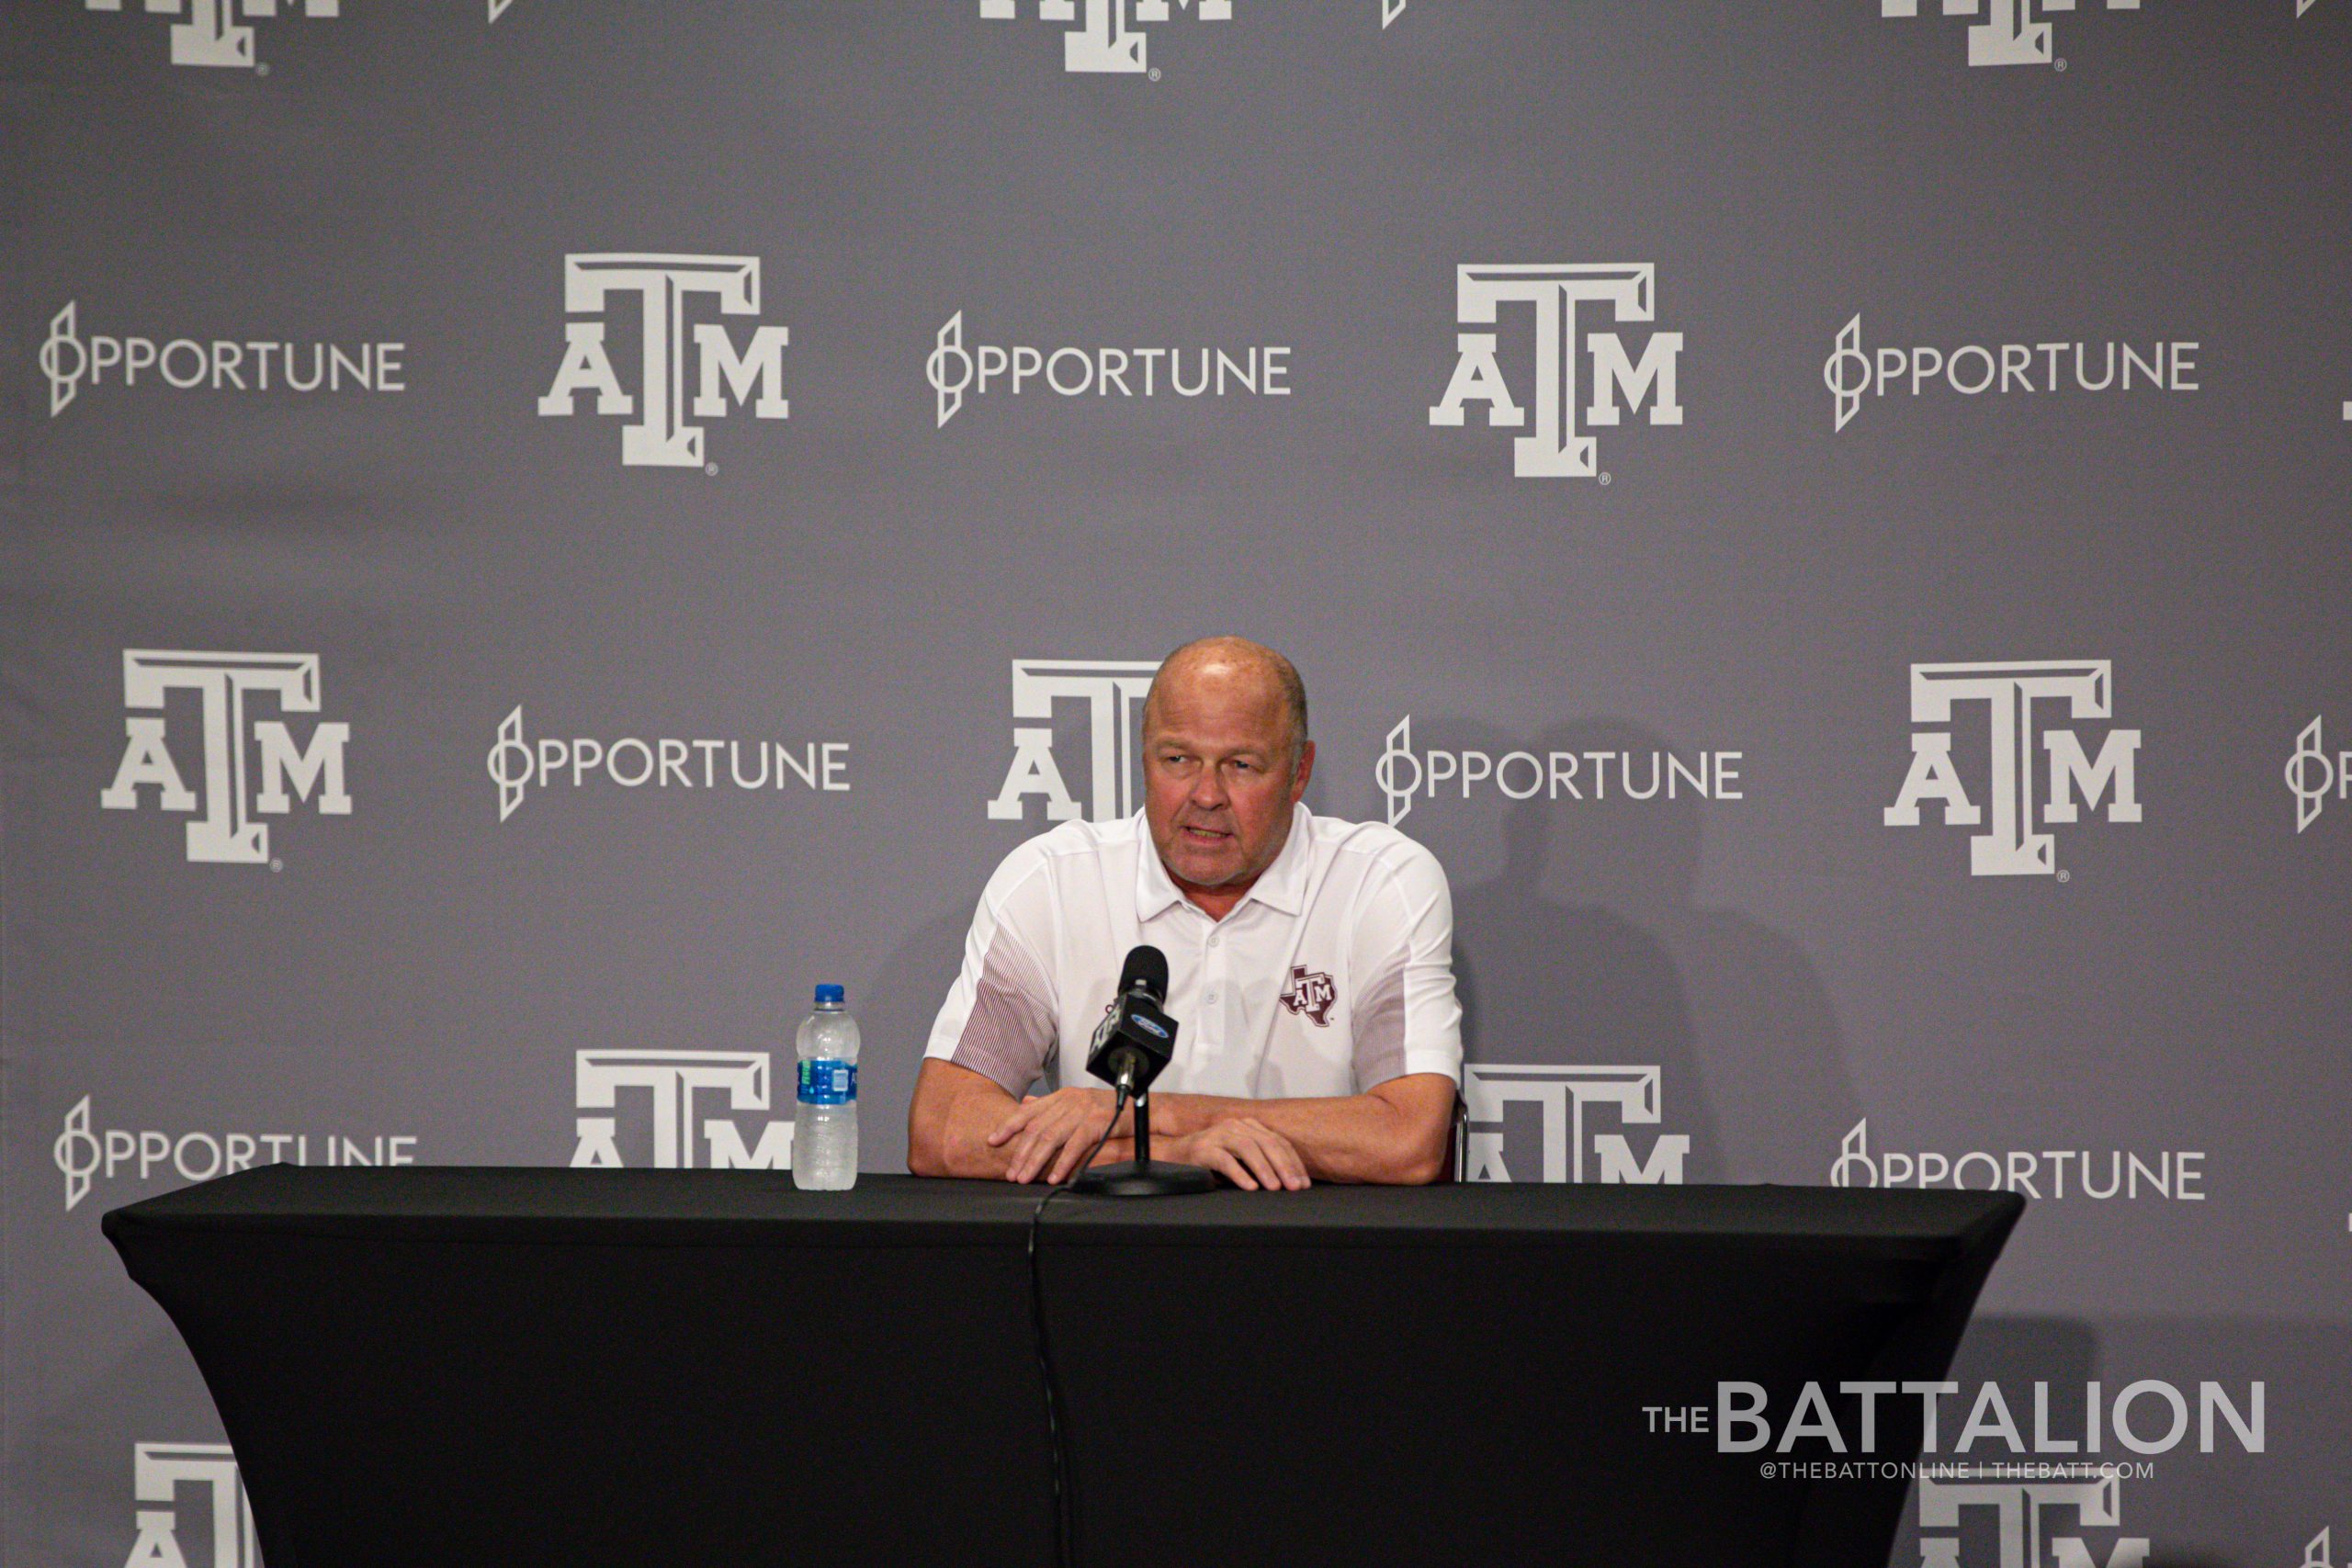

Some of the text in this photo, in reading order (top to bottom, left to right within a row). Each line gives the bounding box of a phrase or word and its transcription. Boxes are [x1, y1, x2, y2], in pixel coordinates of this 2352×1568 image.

[40, 300, 406, 417] OPPORTUNE
[925, 310, 1291, 429] OPPORTUNE
[1823, 311, 2199, 434] OPPORTUNE
[487, 705, 851, 822] OPPORTUNE
[1375, 714, 1743, 828] OPPORTUNE
